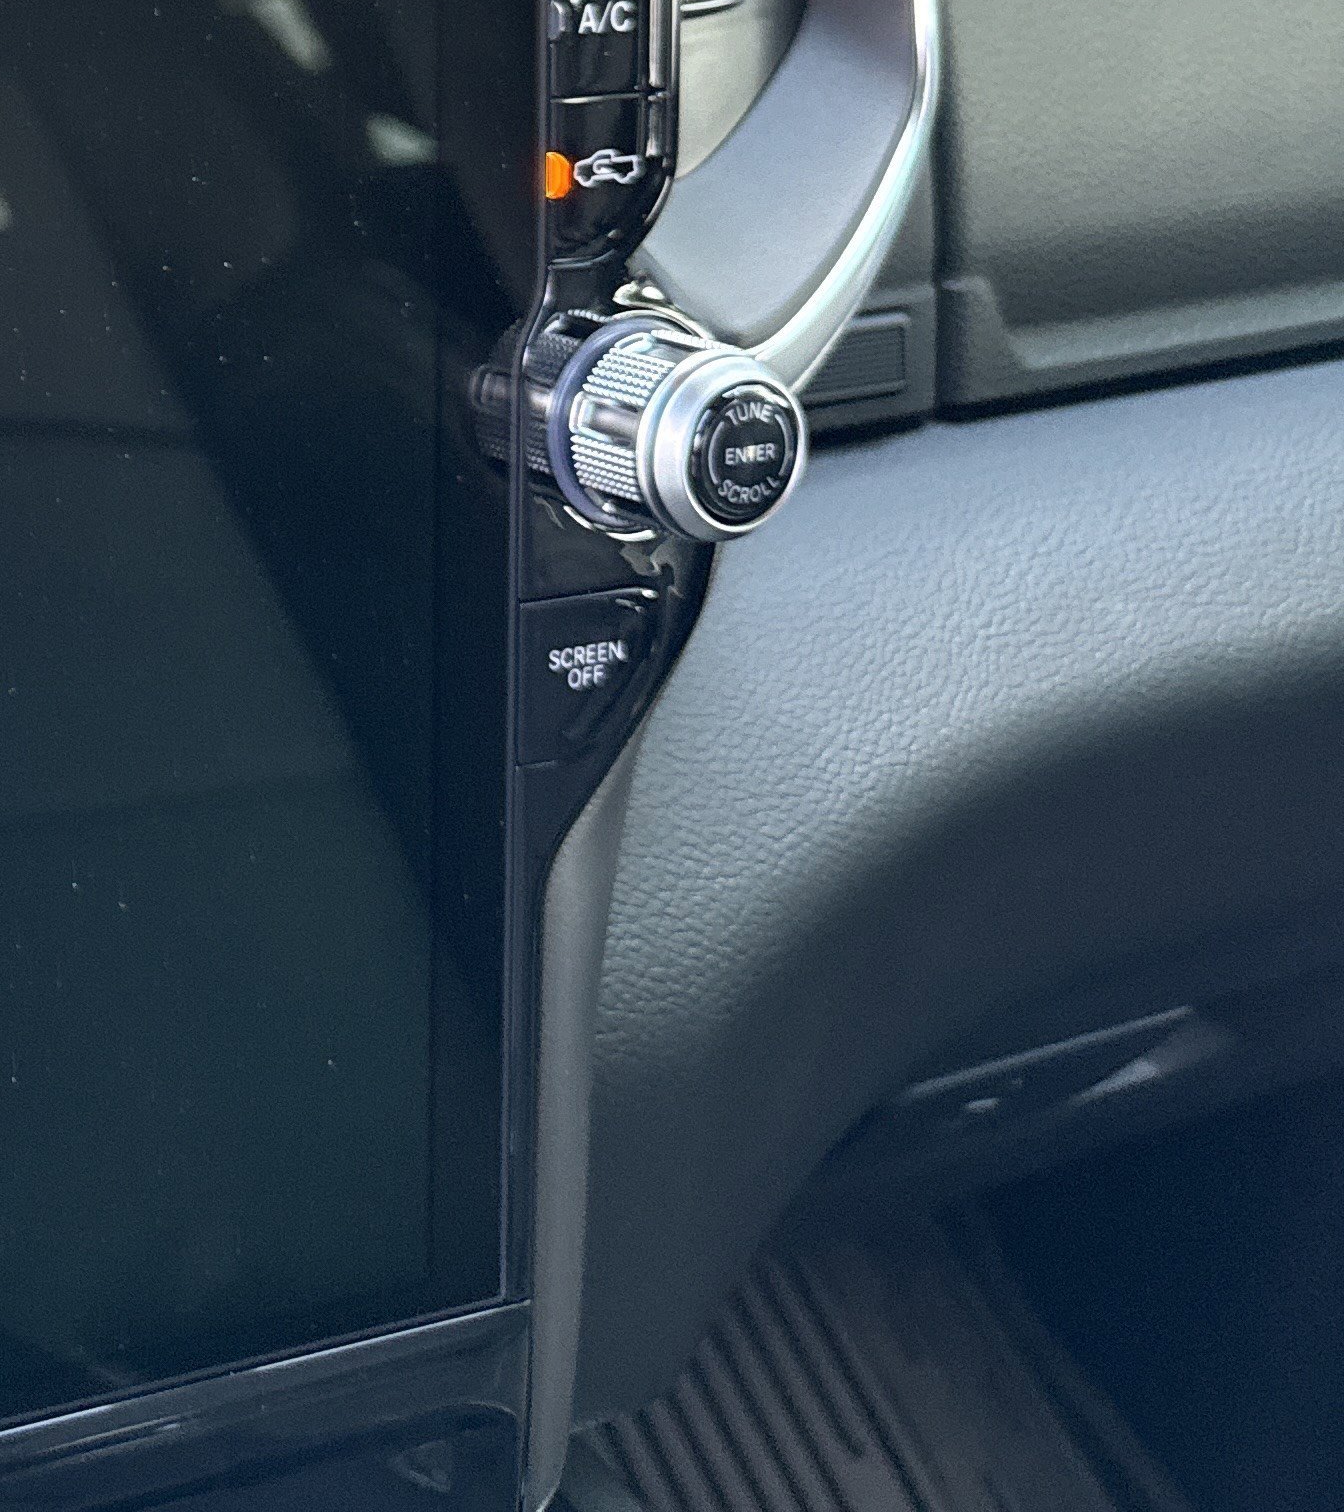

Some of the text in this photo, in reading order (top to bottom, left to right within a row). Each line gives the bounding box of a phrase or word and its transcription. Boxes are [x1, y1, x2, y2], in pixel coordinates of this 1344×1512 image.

[577, 0, 638, 35] A/C
[724, 402, 776, 427] TUNE
[724, 443, 776, 466] ENTER
[716, 476, 782, 505] SCROLL
[547, 640, 628, 673] SCREEN
[567, 665, 608, 690] OFF
